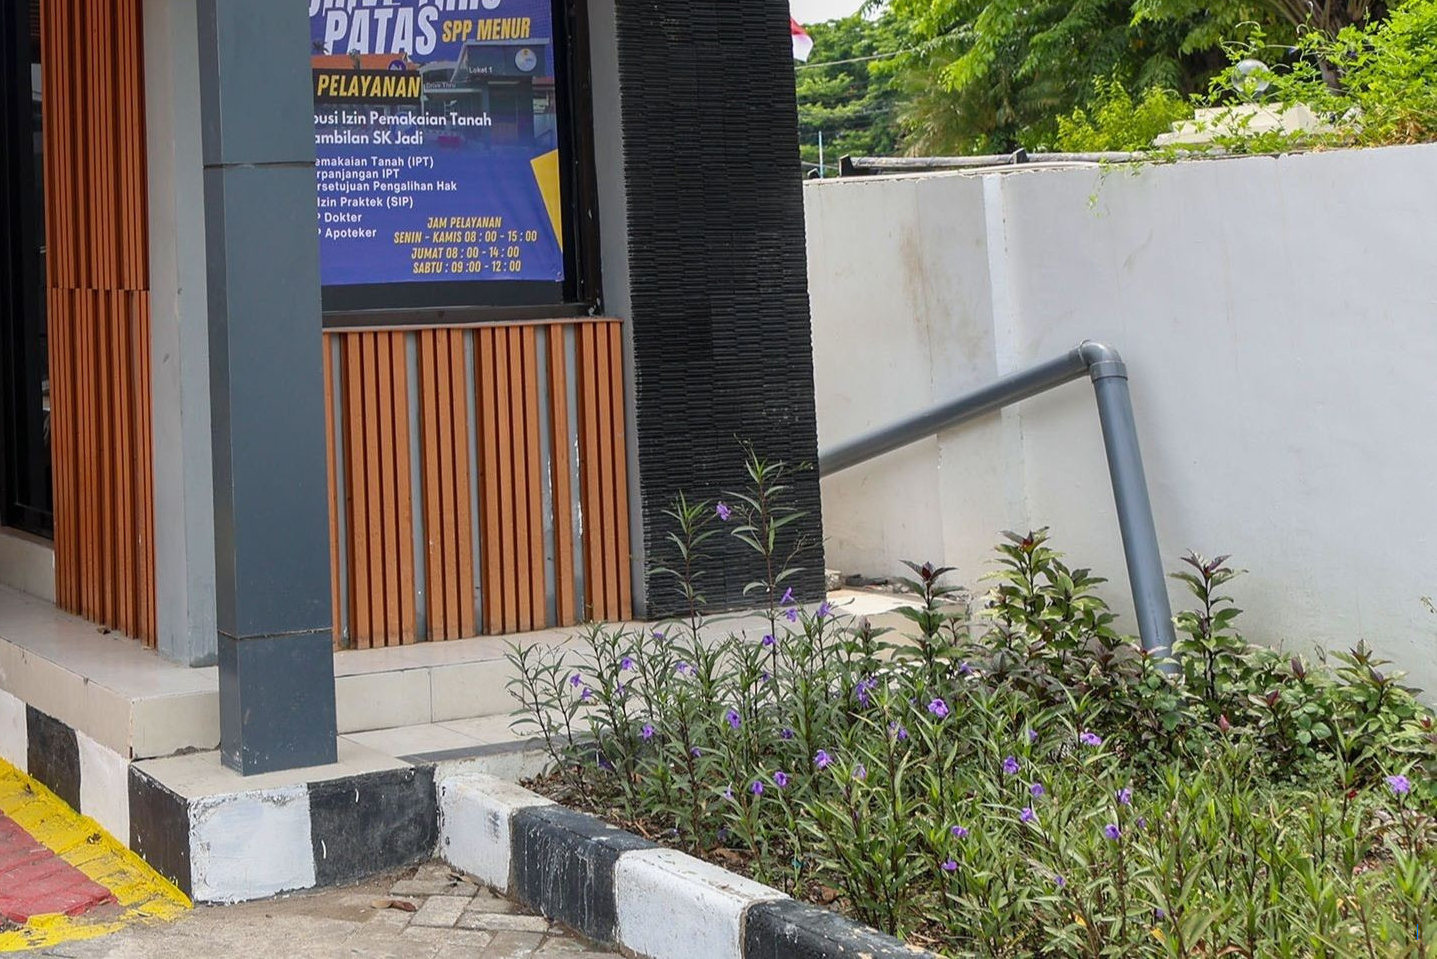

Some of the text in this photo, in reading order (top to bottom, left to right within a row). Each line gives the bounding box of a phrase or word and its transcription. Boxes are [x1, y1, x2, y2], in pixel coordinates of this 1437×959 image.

[324, 5, 439, 57] PATAS
[442, 17, 531, 42] SPP MENUR
[317, 74, 421, 98] PELAYANAN
[342, 111, 367, 125] Izin
[370, 111, 447, 126] Pemakaian
[450, 112, 492, 126] Tanah
[373, 130, 392, 144] SK
[394, 130, 423, 145] Jadi
[371, 156, 404, 167] Tanah
[407, 156, 434, 169] (IPT)
[316, 168, 400, 180] rpanjangan IPT
[317, 180, 457, 193] rsetujuan Pengalihan Hak
[317, 196, 413, 209] Izin Praktek (SIP)
[324, 212, 362, 222] Dokter
[427, 216, 502, 229] JAM PELAYANAN
[325, 227, 377, 240] Apoteker
[394, 231, 422, 244] SENIN
[432, 231, 462, 243] KAMIS
[464, 231, 476, 242] 08
[485, 230, 497, 242] 00
[507, 230, 517, 242] 15
[525, 230, 537, 242] 00
[411, 247, 444, 259] JUMAT
[446, 247, 458, 259] 08
[466, 247, 479, 258] 00
[489, 246, 499, 257] 14
[507, 246, 519, 258] 00
[413, 261, 443, 274] SABTU
[451, 261, 463, 273] 09
[492, 260, 502, 272] 12
[509, 260, 521, 272] 00
